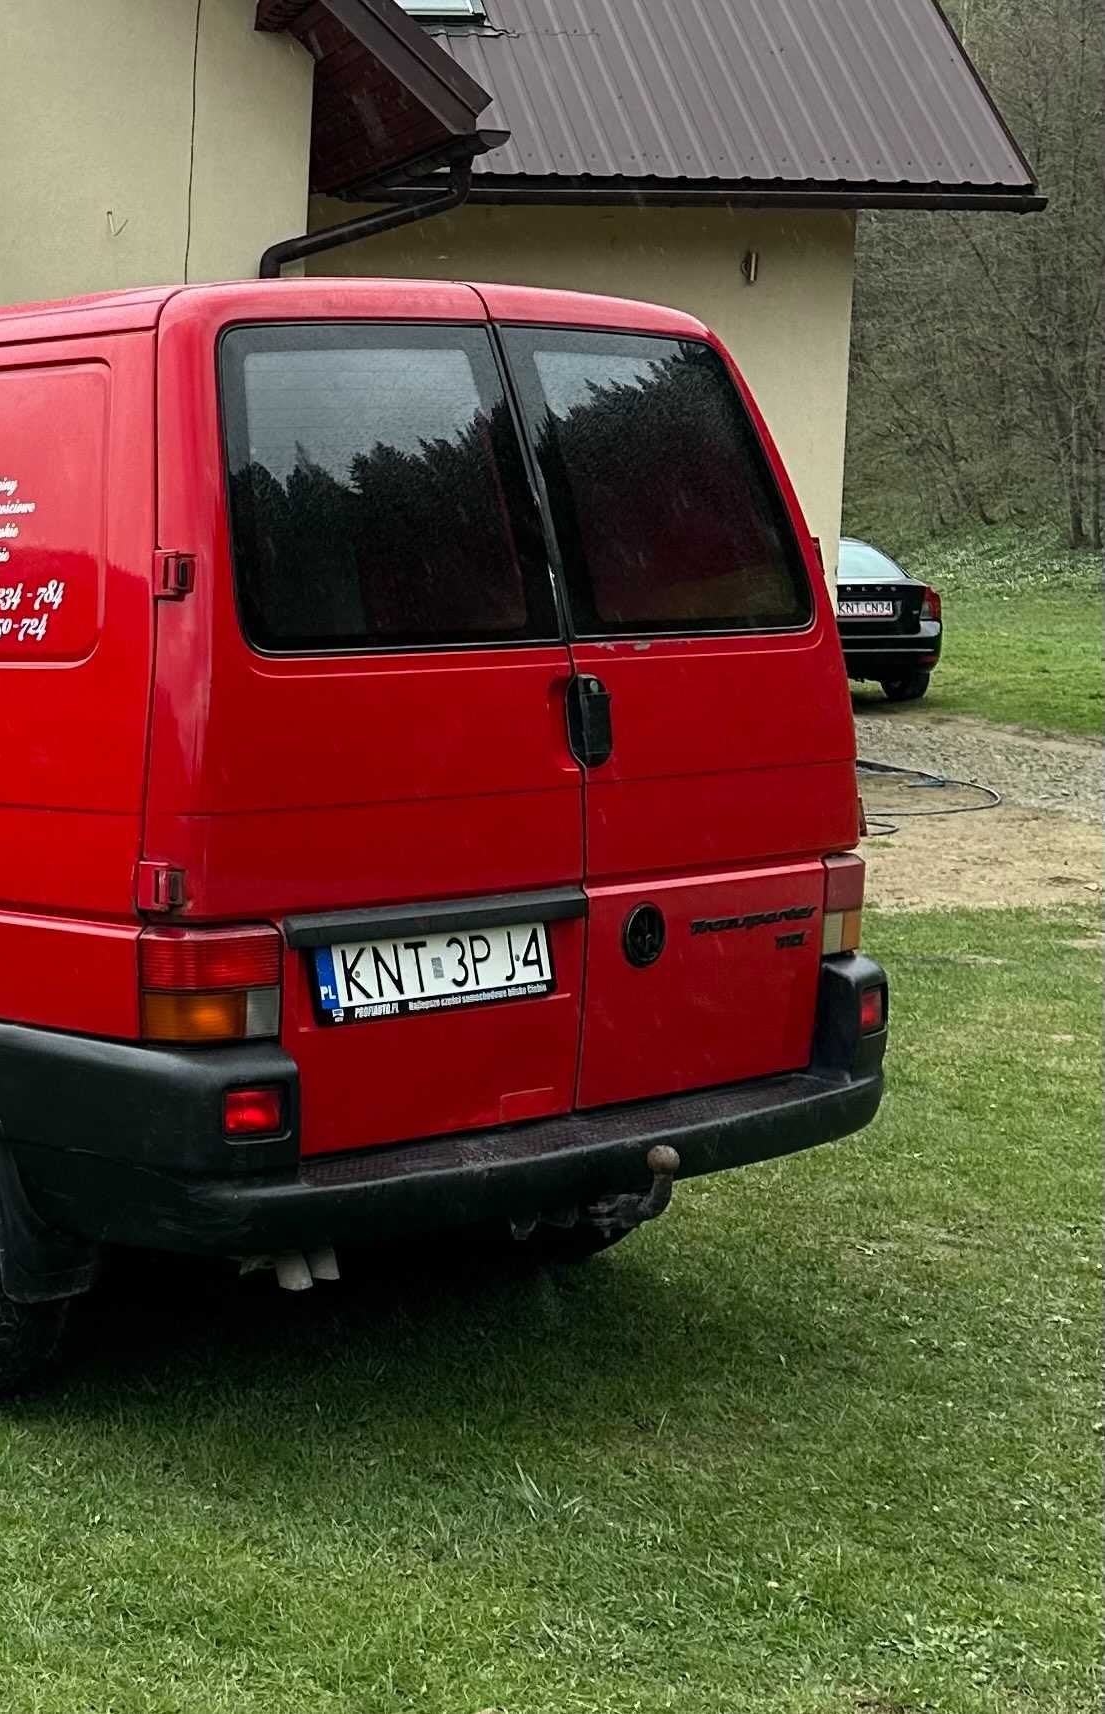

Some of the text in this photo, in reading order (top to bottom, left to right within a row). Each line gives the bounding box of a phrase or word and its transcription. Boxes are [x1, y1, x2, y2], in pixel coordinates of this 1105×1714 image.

[838, 602, 860, 614] KNT
[340, 940, 428, 1002] KNT
[319, 985, 337, 1001] PL
